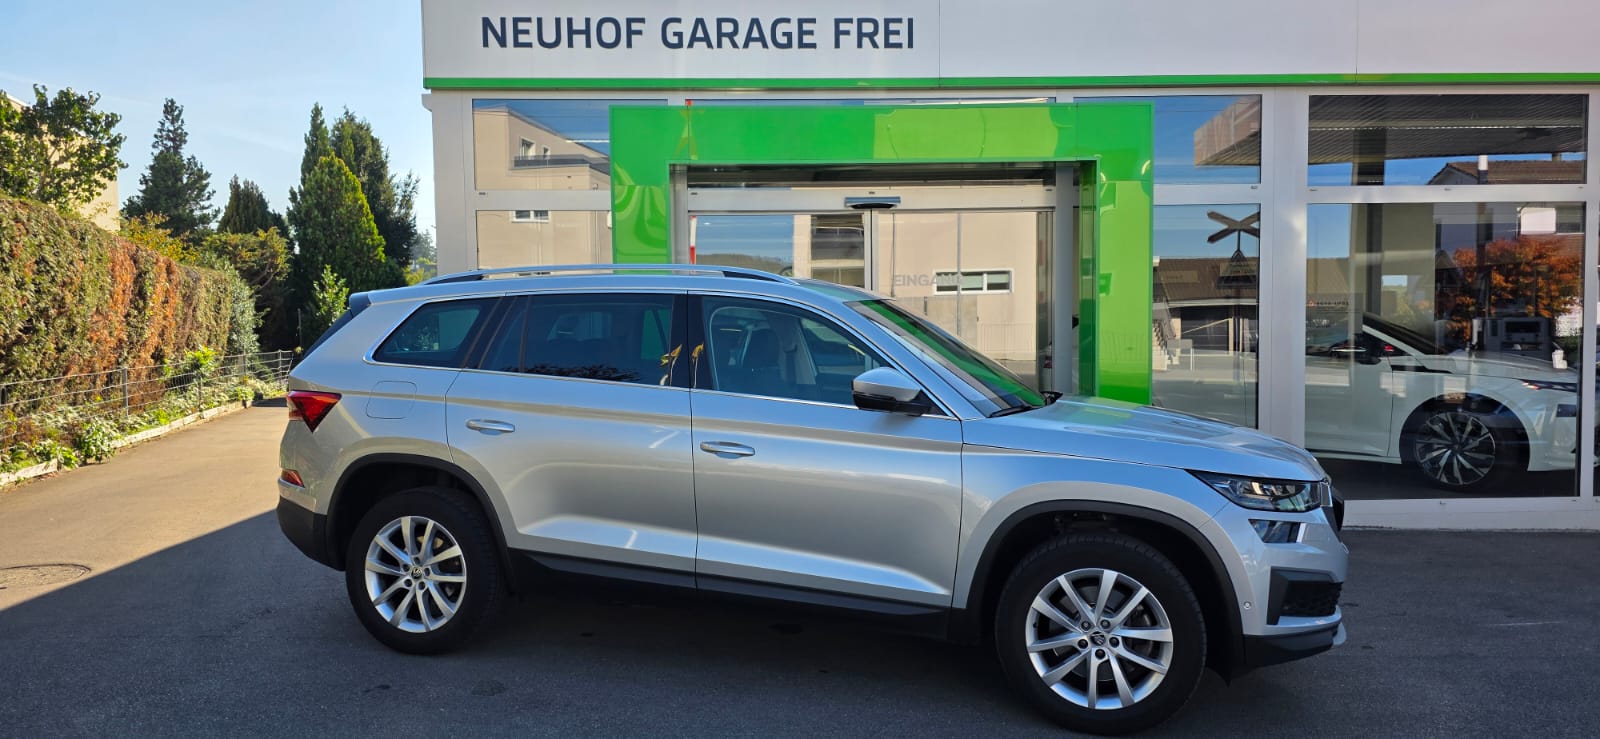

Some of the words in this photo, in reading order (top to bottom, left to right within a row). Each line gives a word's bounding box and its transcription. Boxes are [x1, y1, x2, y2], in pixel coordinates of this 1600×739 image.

[481, 16, 646, 49] NEUHOF
[661, 17, 817, 49] GARAGE
[833, 17, 914, 49] FREI
